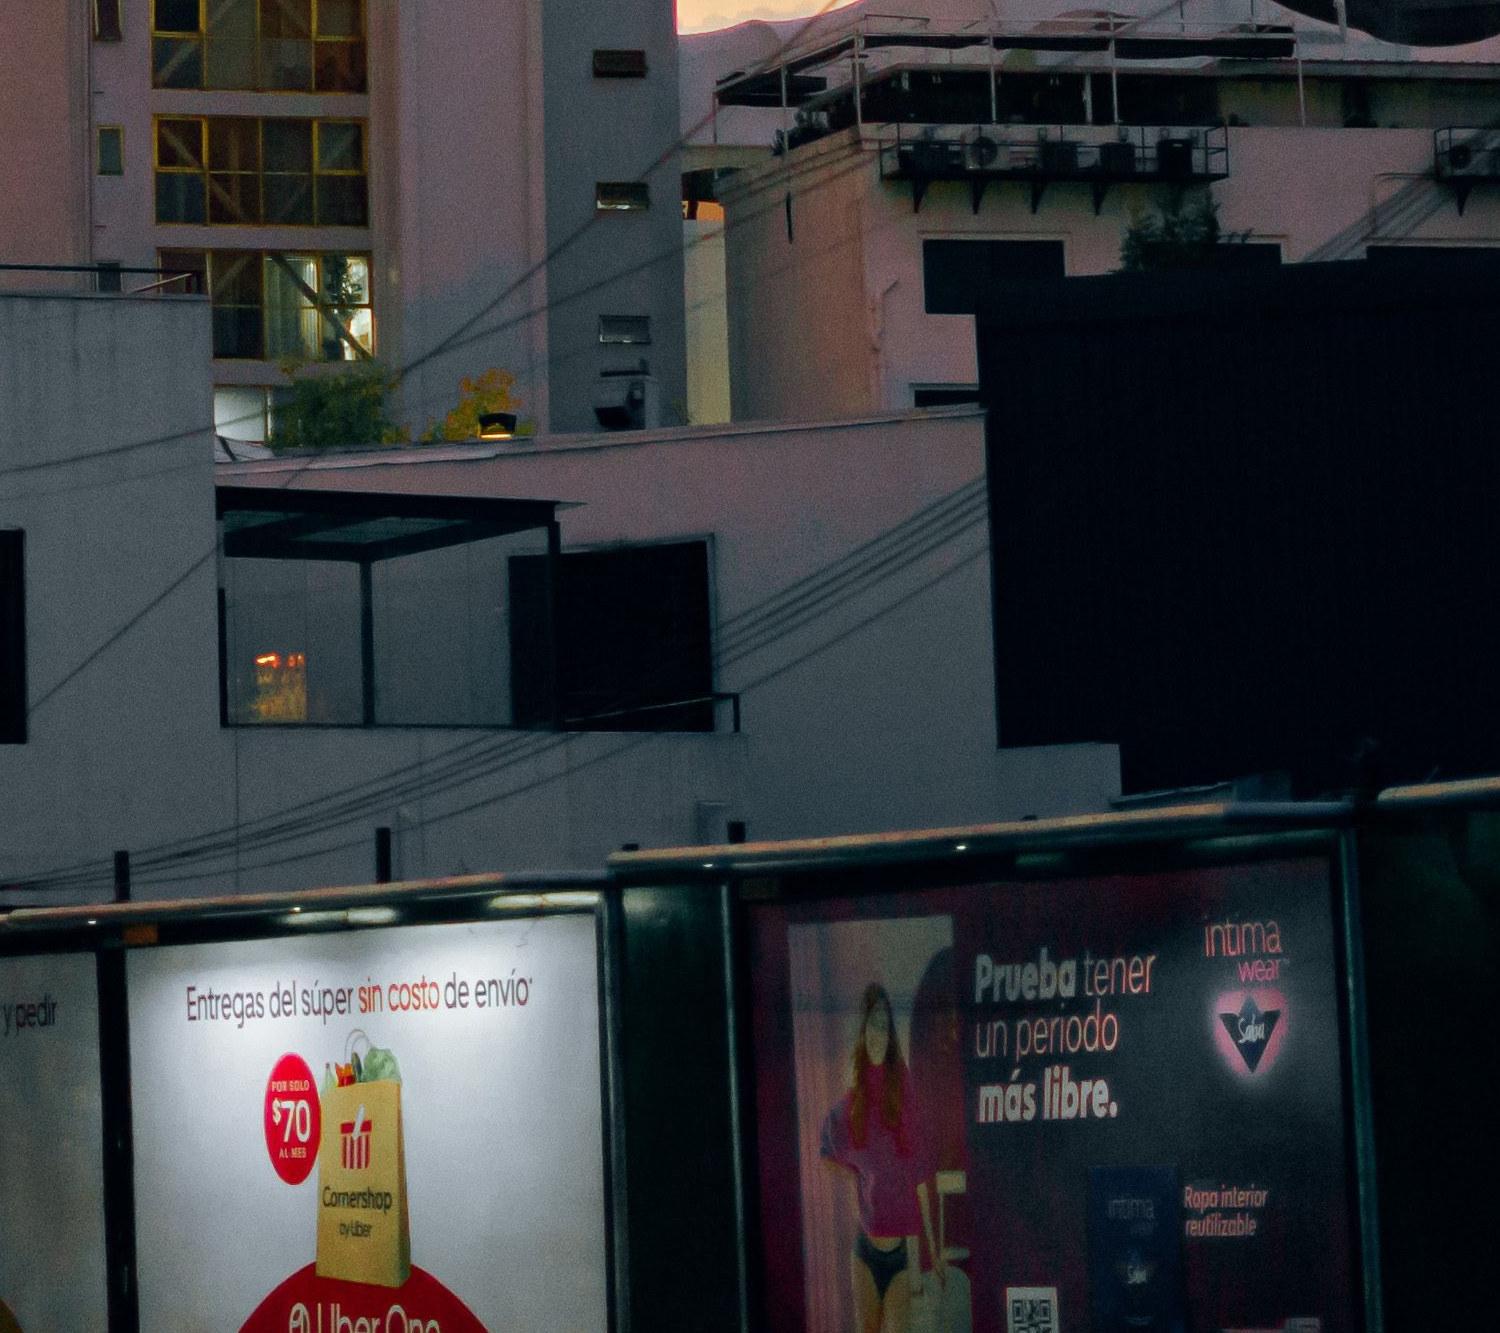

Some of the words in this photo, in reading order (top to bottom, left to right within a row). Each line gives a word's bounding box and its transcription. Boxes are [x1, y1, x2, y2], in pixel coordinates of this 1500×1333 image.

[187, 985, 265, 1029] Entregas
[269, 980, 296, 1018] del
[301, 979, 354, 1026] súper
[357, 976, 384, 1014] sin
[388, 975, 440, 1012] costo
[444, 972, 470, 1010] de
[975, 946, 1077, 1004] Prueba
[1083, 949, 1157, 997] tener
[15, 994, 58, 1034] pedir
[976, 1020, 1008, 1058] un
[1016, 998, 1119, 1063] periodo
[272, 1097, 311, 1143] $70
[978, 1068, 1037, 1123] más
[1042, 1065, 1118, 1121] libre.
[322, 1185, 393, 1215] Cornershop
